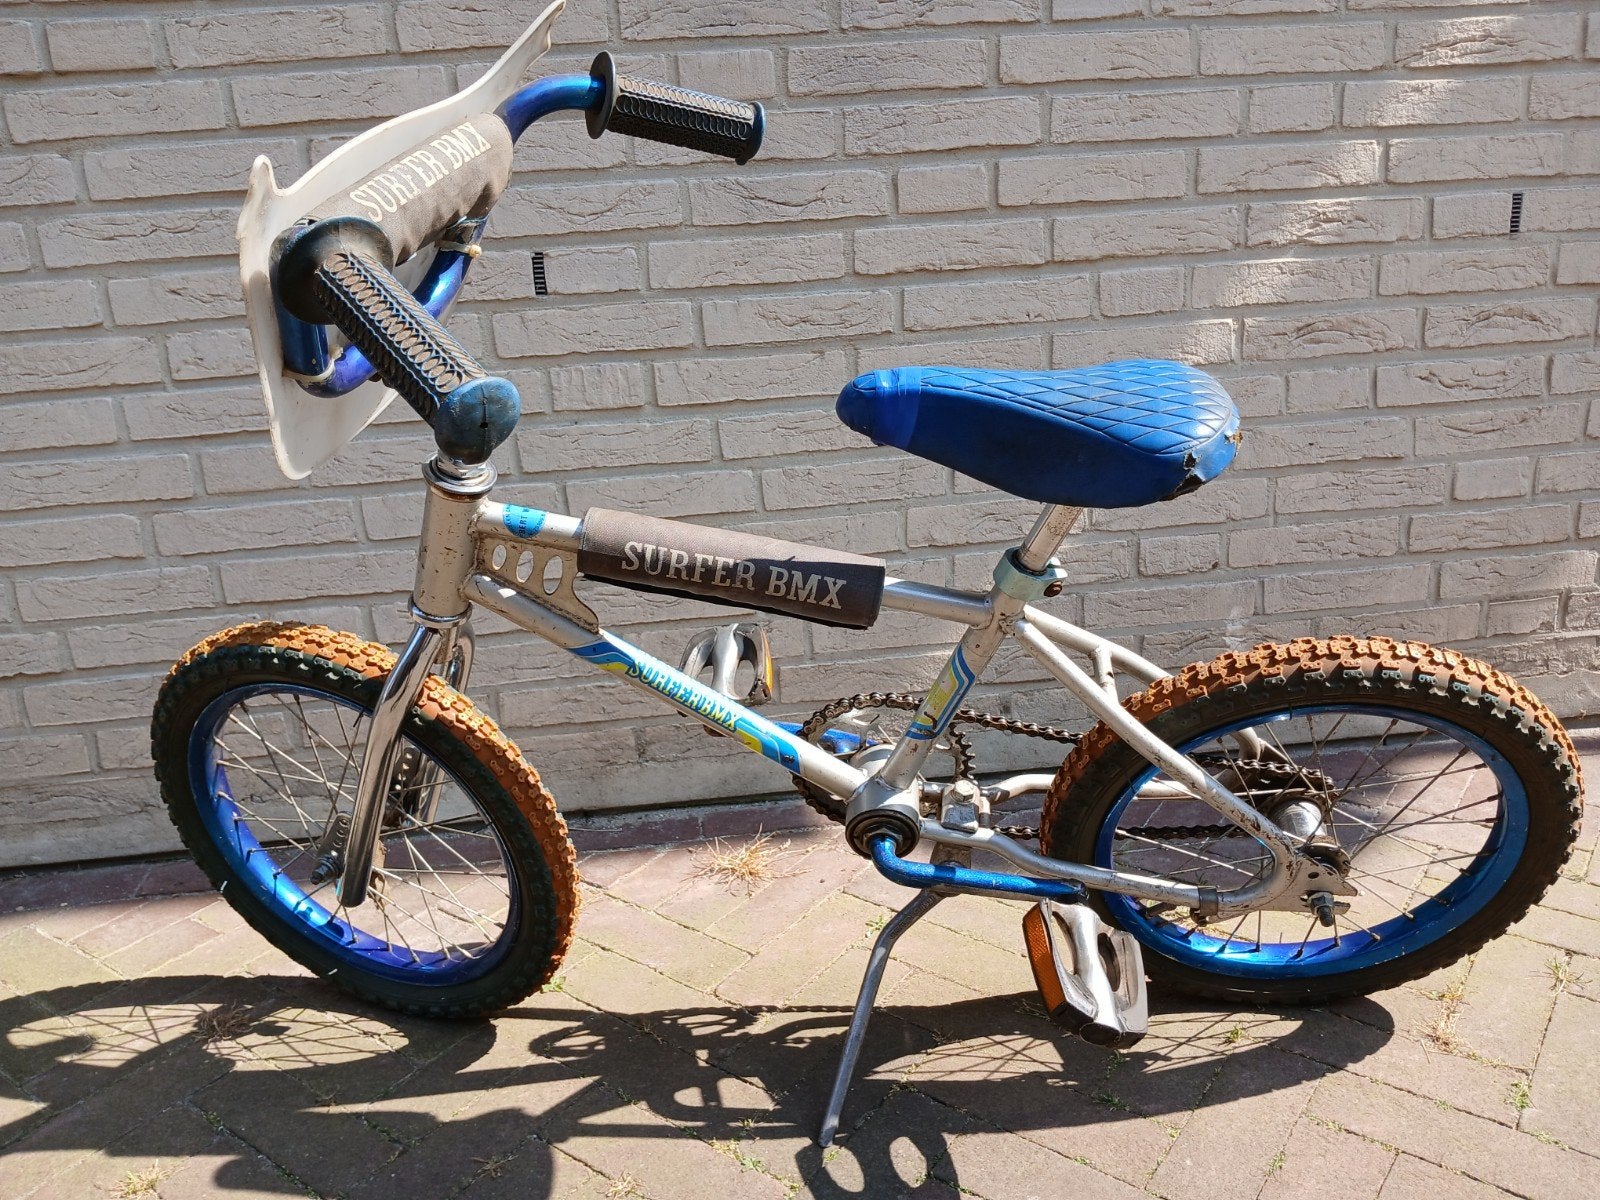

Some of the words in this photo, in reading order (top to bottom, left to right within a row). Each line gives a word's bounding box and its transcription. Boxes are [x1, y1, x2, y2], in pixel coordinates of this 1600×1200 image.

[350, 150, 450, 223] SURFER
[429, 122, 492, 170] BMX
[621, 541, 755, 592] SURFER
[764, 565, 847, 610] BMX
